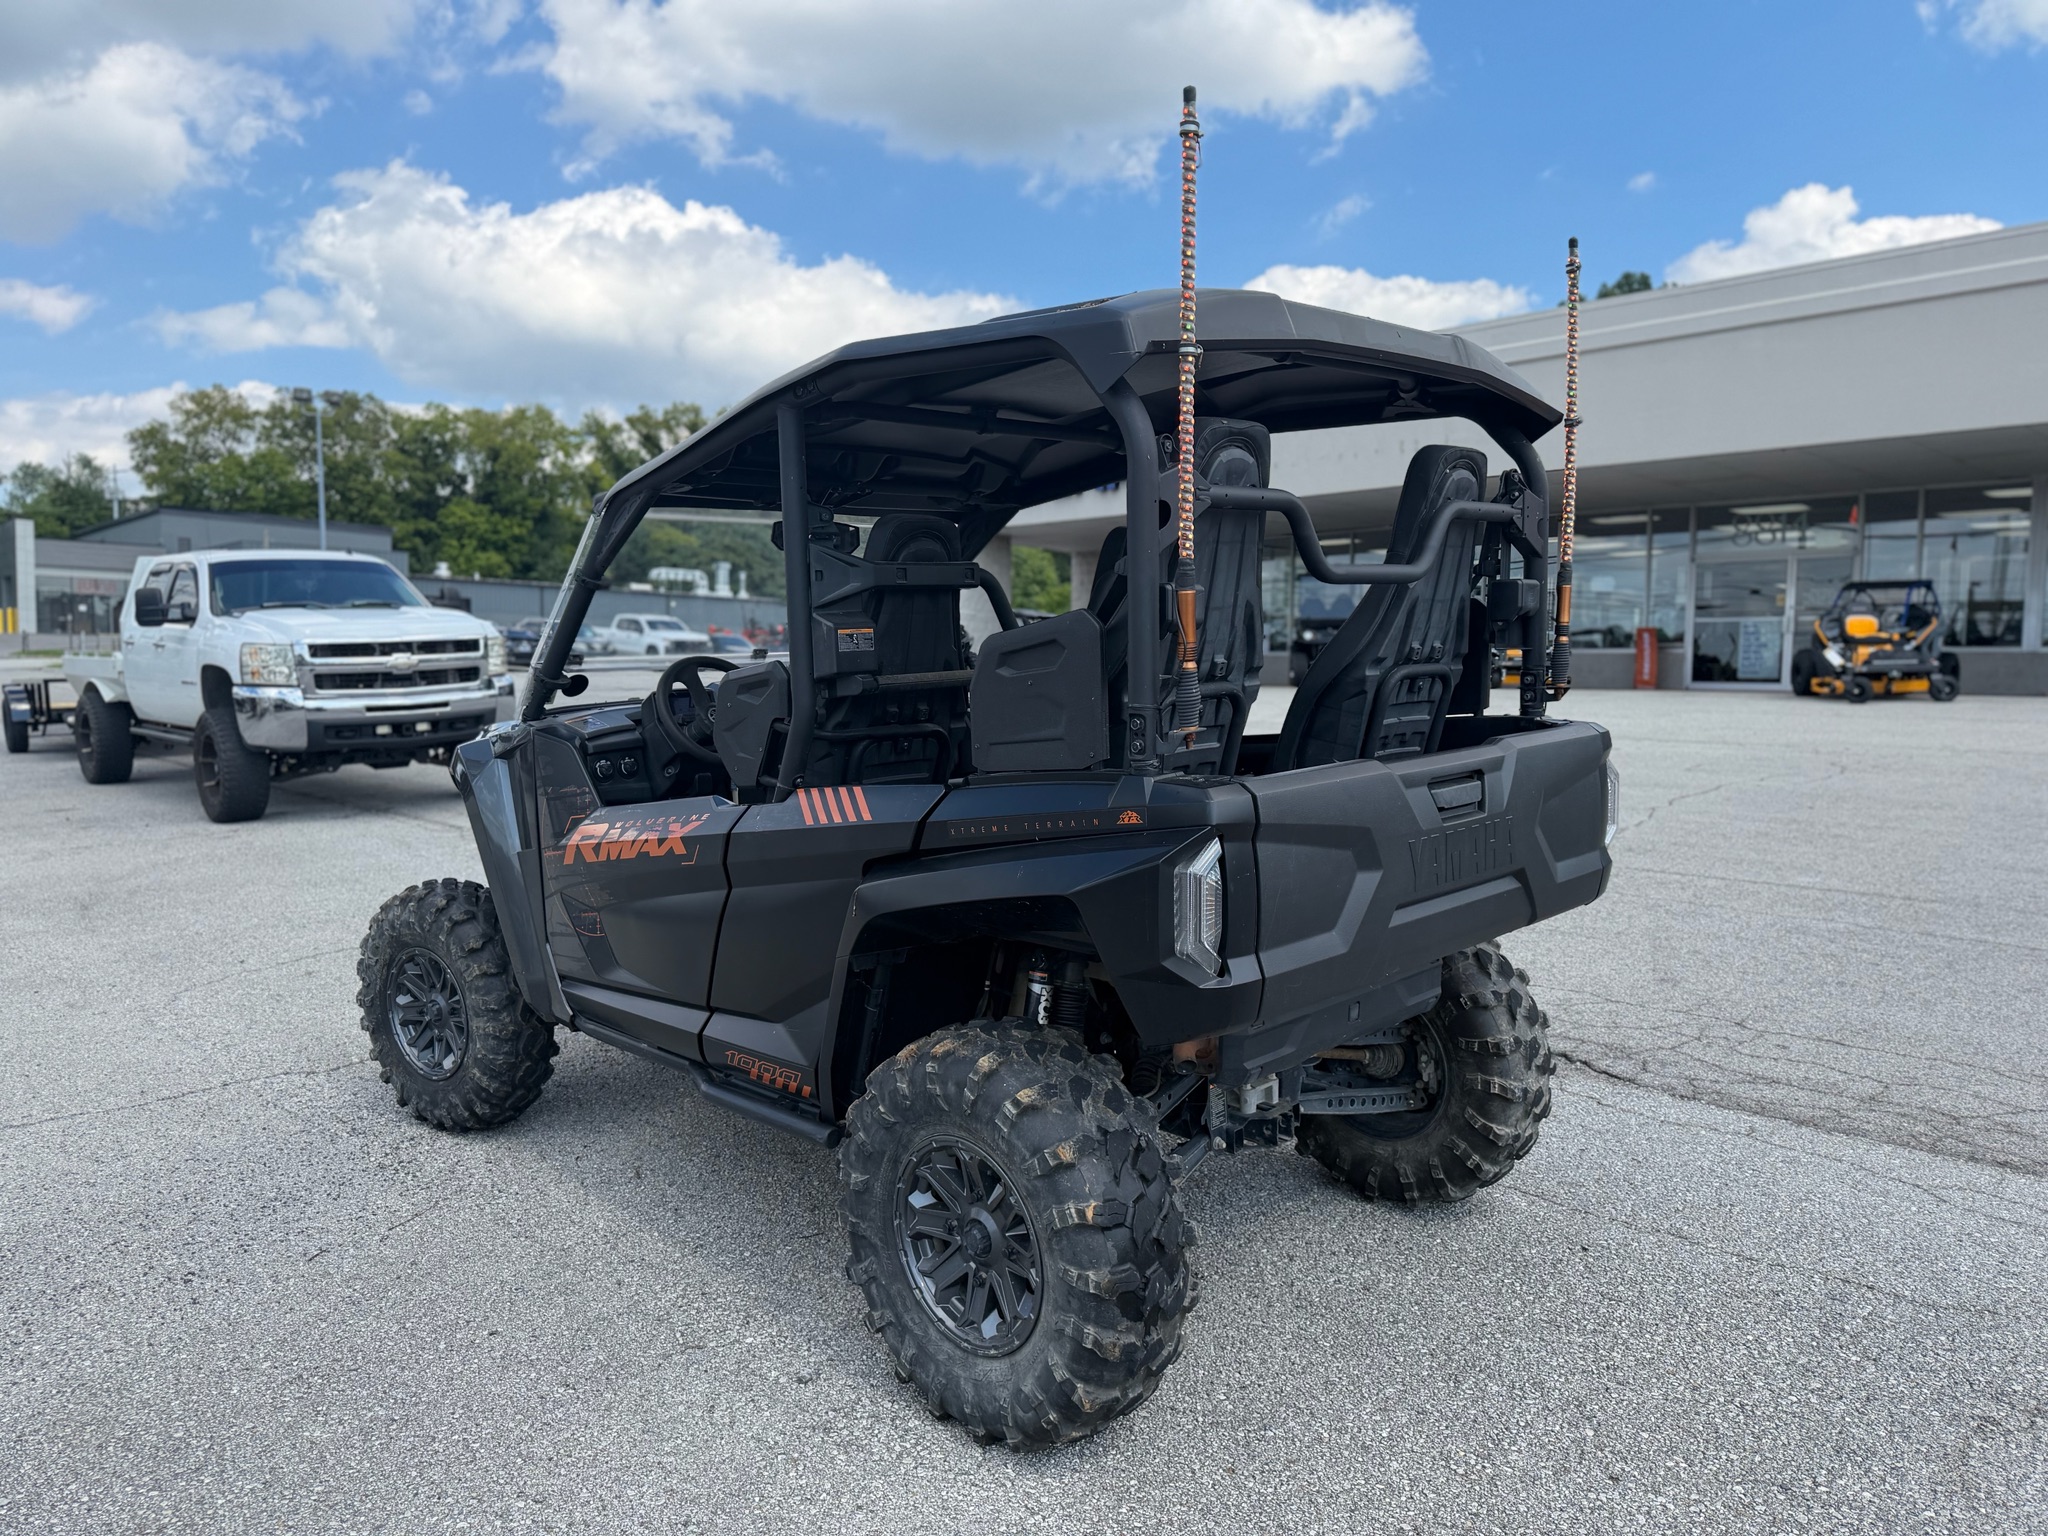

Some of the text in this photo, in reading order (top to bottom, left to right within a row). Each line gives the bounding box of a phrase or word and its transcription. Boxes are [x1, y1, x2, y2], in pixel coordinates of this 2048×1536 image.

[563, 820, 705, 865] RMAX
[950, 818, 1099, 835] XTREME TERRAIN
[1407, 815, 1514, 893] YAMAHA
